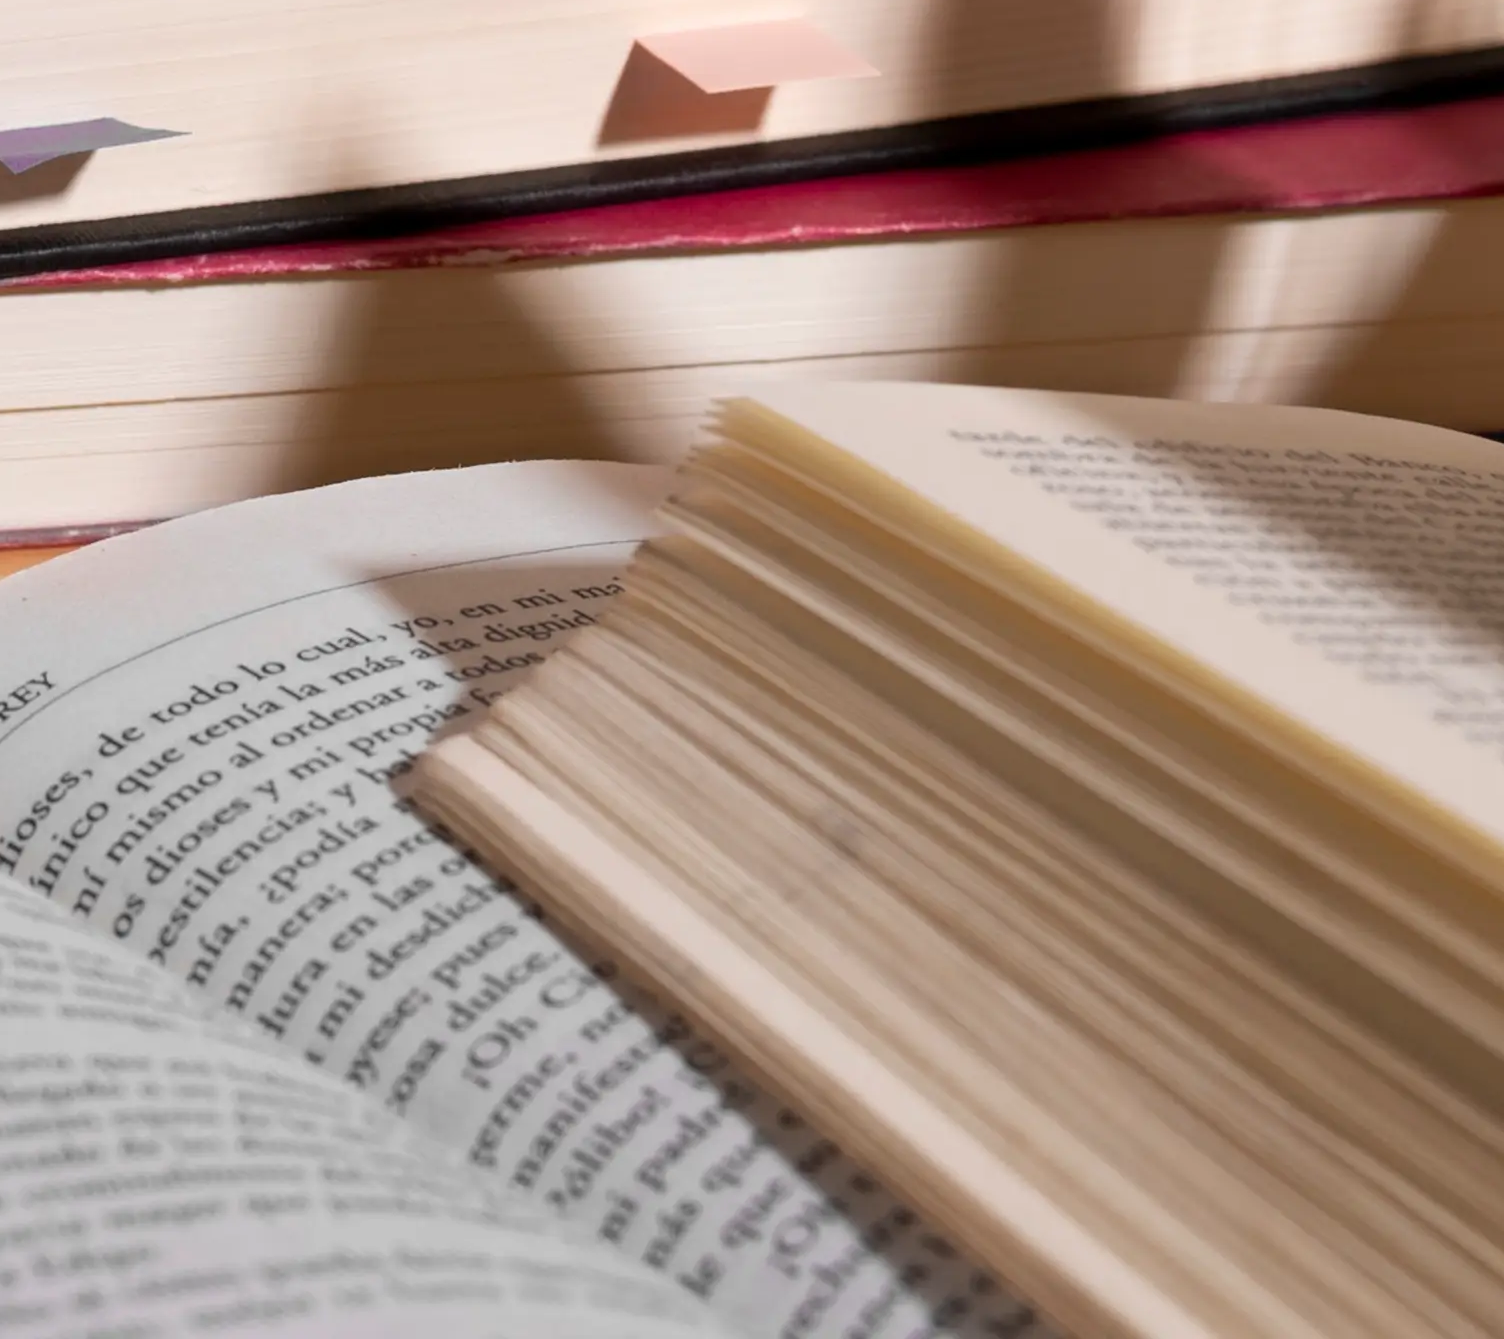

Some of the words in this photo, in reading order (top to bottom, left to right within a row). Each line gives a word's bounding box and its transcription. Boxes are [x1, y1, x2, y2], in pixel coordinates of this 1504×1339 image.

[97, 725, 146, 759] de
[149, 680, 239, 725] todo
[237, 659, 287, 683] lo
[295, 626, 388, 663] cual,
[390, 614, 455, 641] yo,
[458, 601, 508, 620] en
[511, 588, 567, 611] mi
[115, 745, 186, 797] que
[188, 693, 284, 748] tenía
[278, 678, 326, 704] la
[328, 653, 406, 687] más
[410, 634, 482, 663] alta
[482, 608, 599, 642] dignid
[105, 768, 224, 867] mismo
[228, 741, 266, 770] al
[269, 686, 412, 749] ordenar
[416, 677, 444, 694] a
[444, 649, 546, 683] todos
[144, 796, 253, 887] dioses
[254, 779, 282, 803] y
[287, 744, 345, 782] mi
[347, 699, 472, 759] propia
[329, 780, 358, 808] y
[258, 814, 381, 905] ¿podía
[329, 911, 381, 955] en
[370, 874, 437, 912] las
[429, 919, 520, 991] pues
[315, 977, 366, 1041] mi
[446, 950, 561, 1033] dulce.
[460, 1014, 540, 1091] ¡Oh
